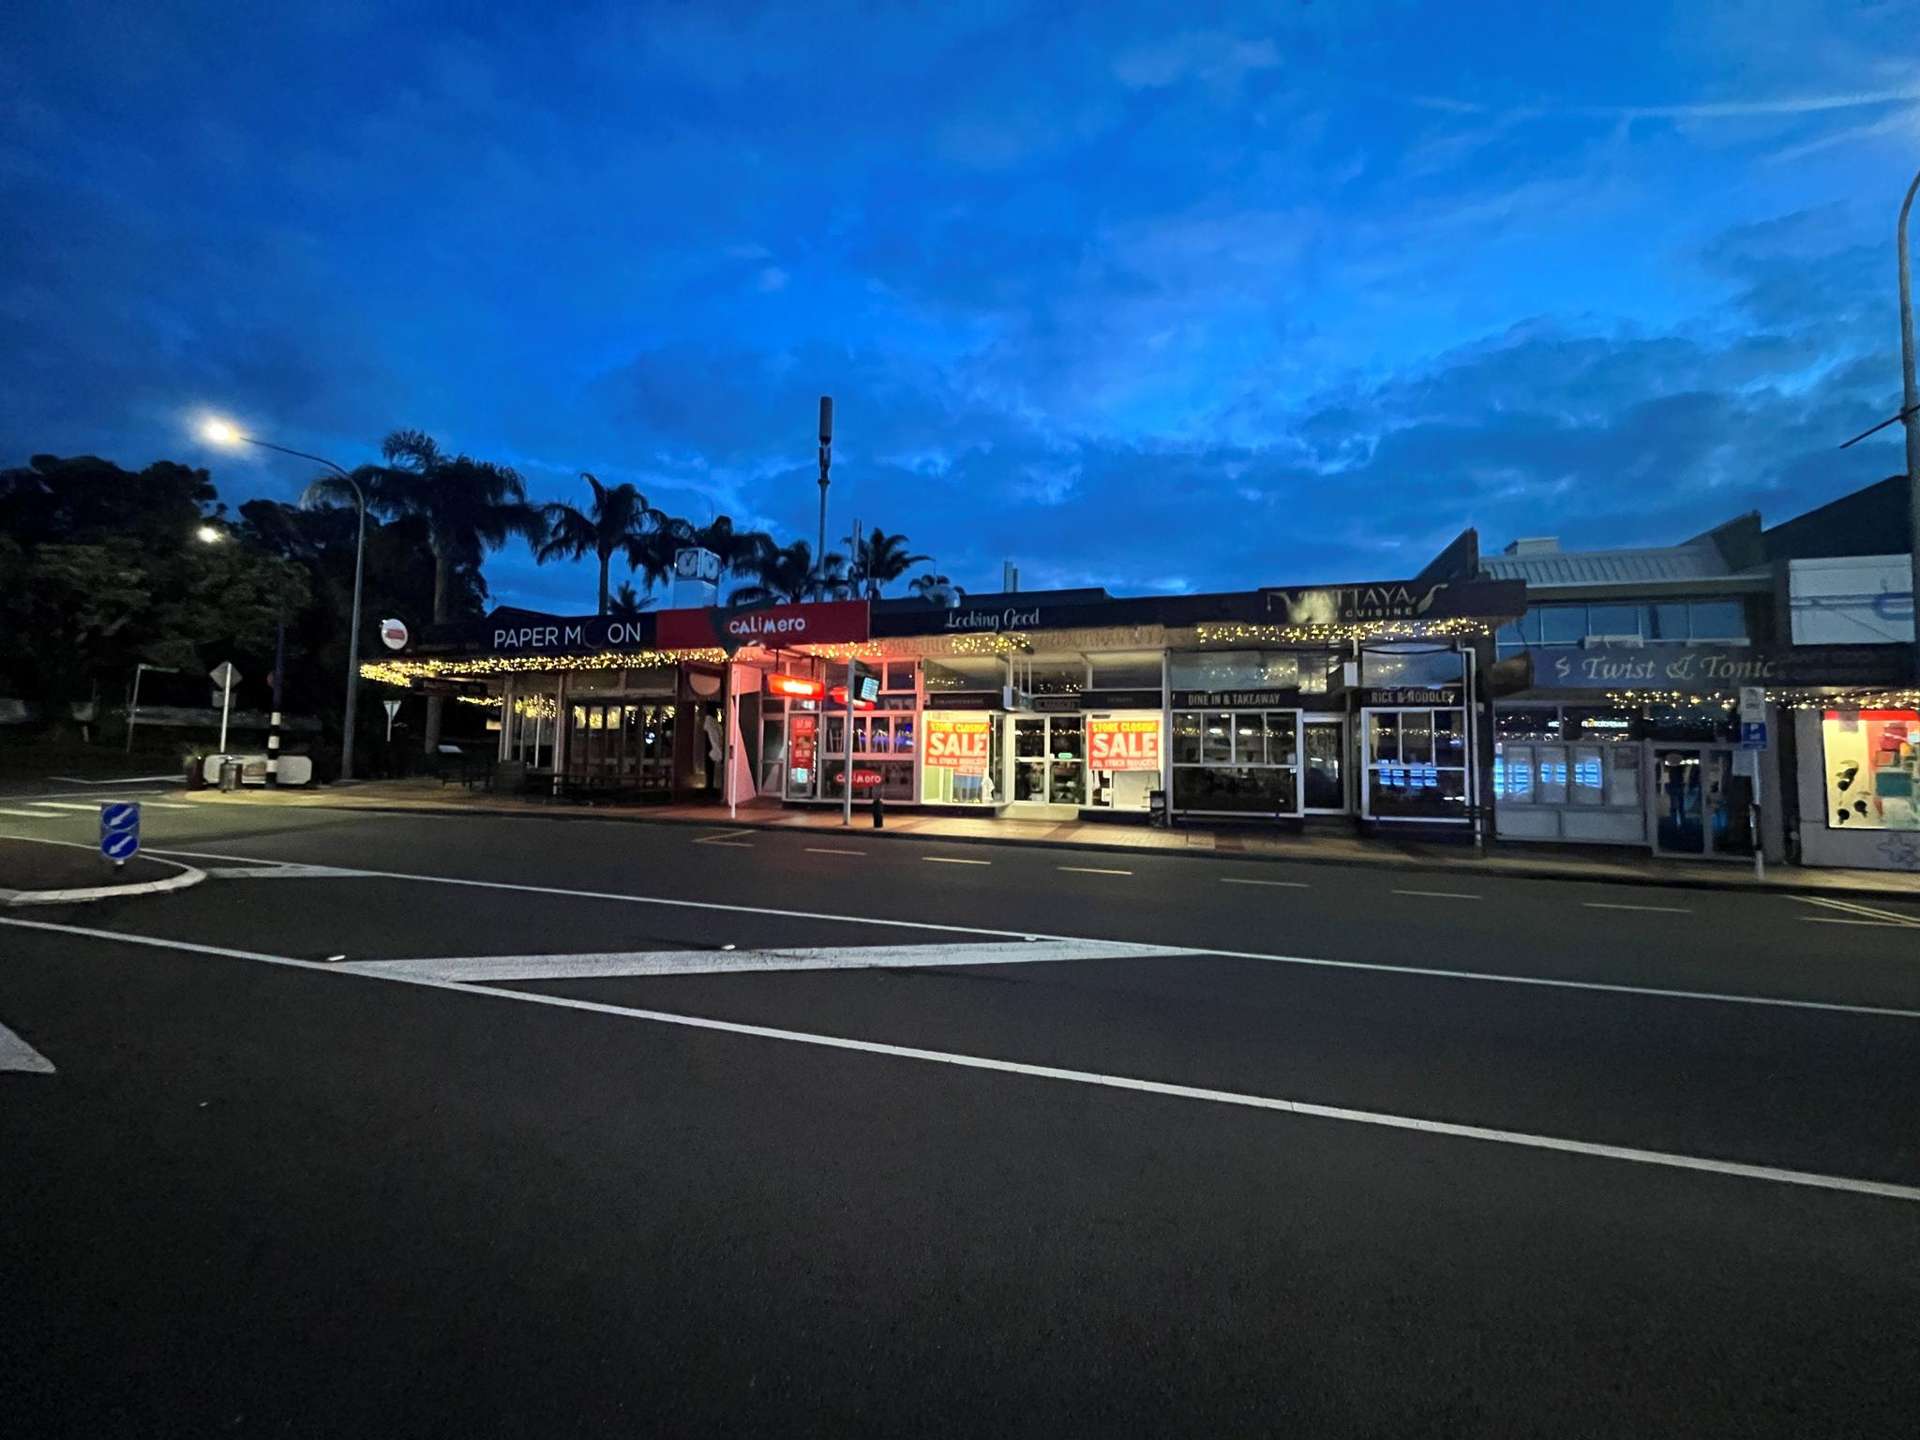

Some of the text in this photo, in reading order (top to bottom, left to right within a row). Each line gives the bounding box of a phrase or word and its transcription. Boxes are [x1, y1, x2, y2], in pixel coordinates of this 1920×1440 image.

[1298, 586, 1416, 609] ATTAYA
[944, 607, 1040, 632] Looking Good
[494, 626, 558, 648] PAPER
[1582, 656, 1656, 679] Twist
[1665, 654, 1697, 680] &
[1701, 654, 1775, 680] Tonic
[1188, 694, 1208, 706] DINE
[1211, 694, 1221, 705] IN
[1232, 693, 1280, 705] TAKEAWAY
[1371, 691, 1393, 703] RICE
[928, 731, 987, 756] SALE
[1092, 732, 1157, 758] SALE
